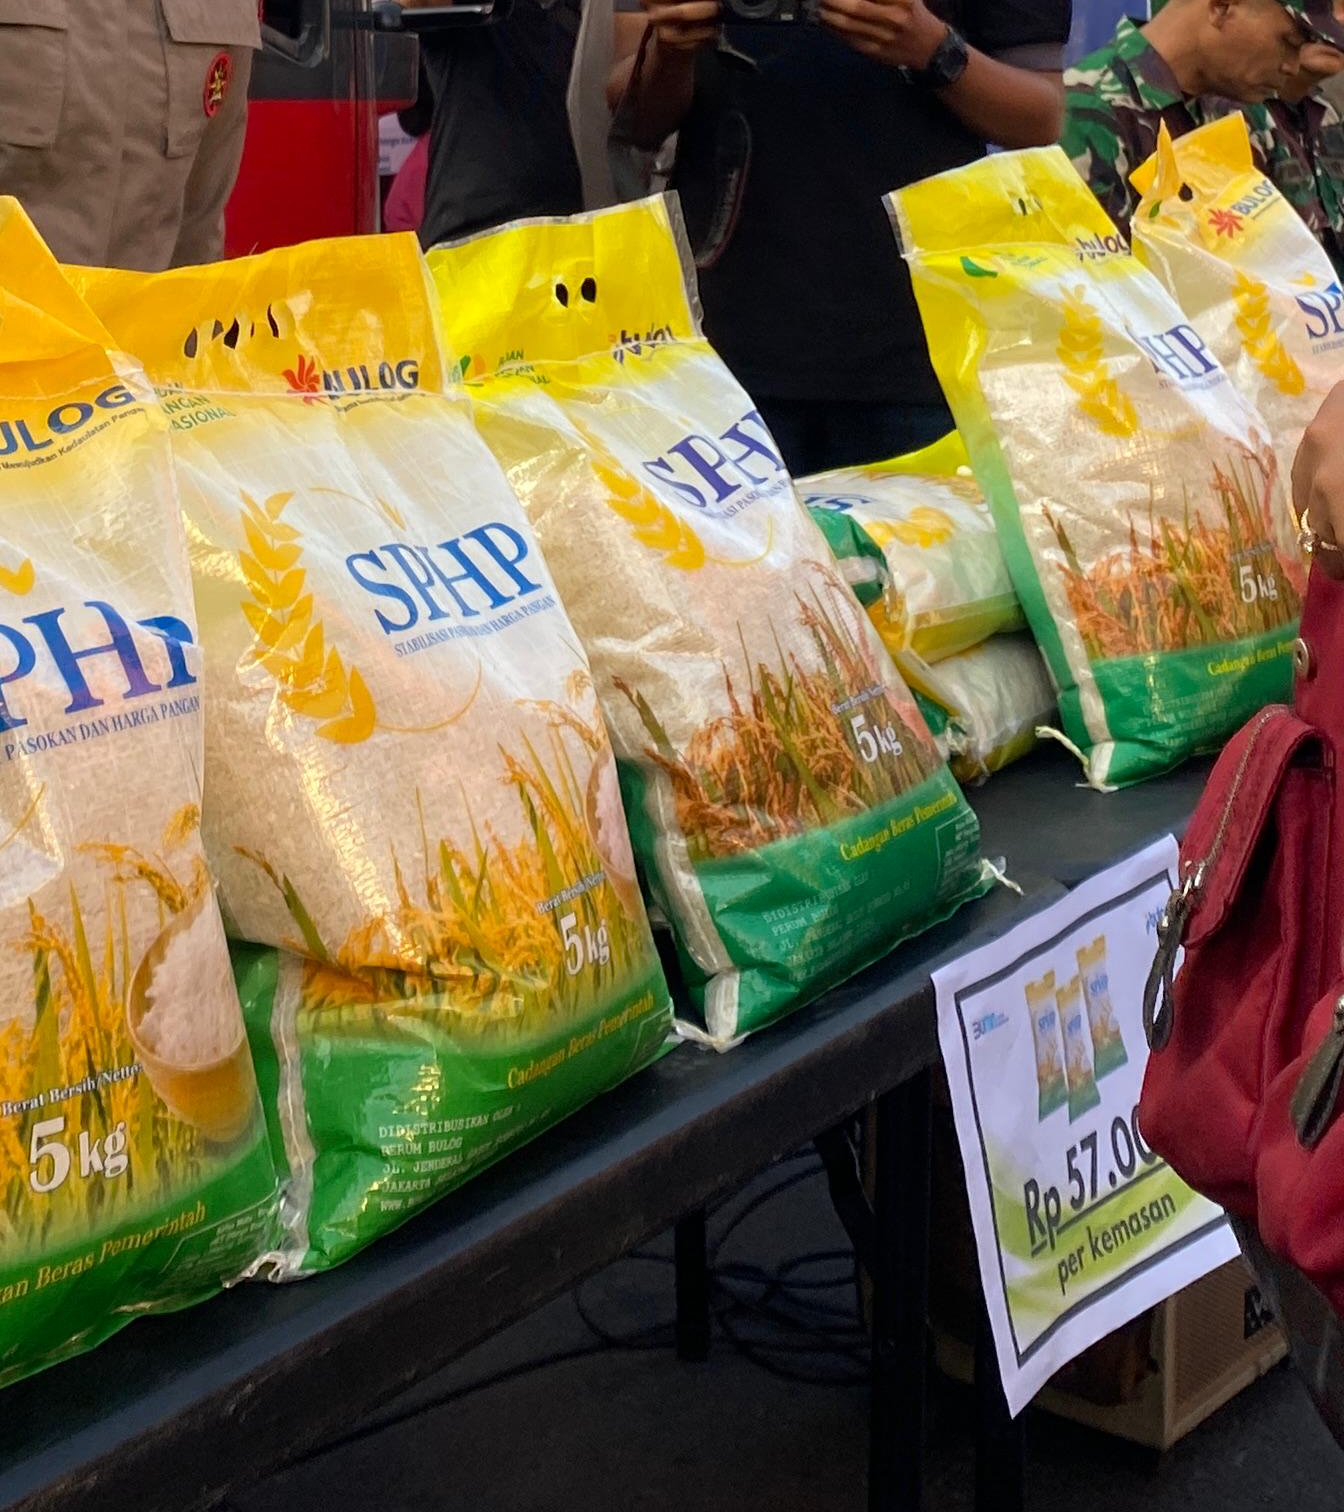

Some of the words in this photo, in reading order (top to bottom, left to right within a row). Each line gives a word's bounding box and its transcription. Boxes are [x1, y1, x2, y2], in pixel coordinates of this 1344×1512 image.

[1141, 324, 1219, 380] HP
[345, 522, 543, 636] SPHP
[1239, 565, 1257, 603] 5
[1257, 572, 1278, 601] kg
[5, 726, 77, 761] PASOKAN
[79, 719, 109, 742] DAN
[110, 705, 160, 734] HARGA
[850, 714, 878, 763] 5
[873, 721, 903, 756] kg
[560, 911, 584, 976] 5
[584, 918, 610, 966] kg
[507, 1047, 567, 1090] Cadangan
[1, 1092, 45, 1117] Berat
[29, 1116, 71, 1193] 5
[78, 1121, 129, 1179] kg
[1023, 1177, 1062, 1252] Rp
[1057, 1243, 1085, 1296] per
[1086, 1192, 1177, 1262] kemasan
[34, 1251, 95, 1291] Beras
[98, 1199, 206, 1264] Pemerintah
